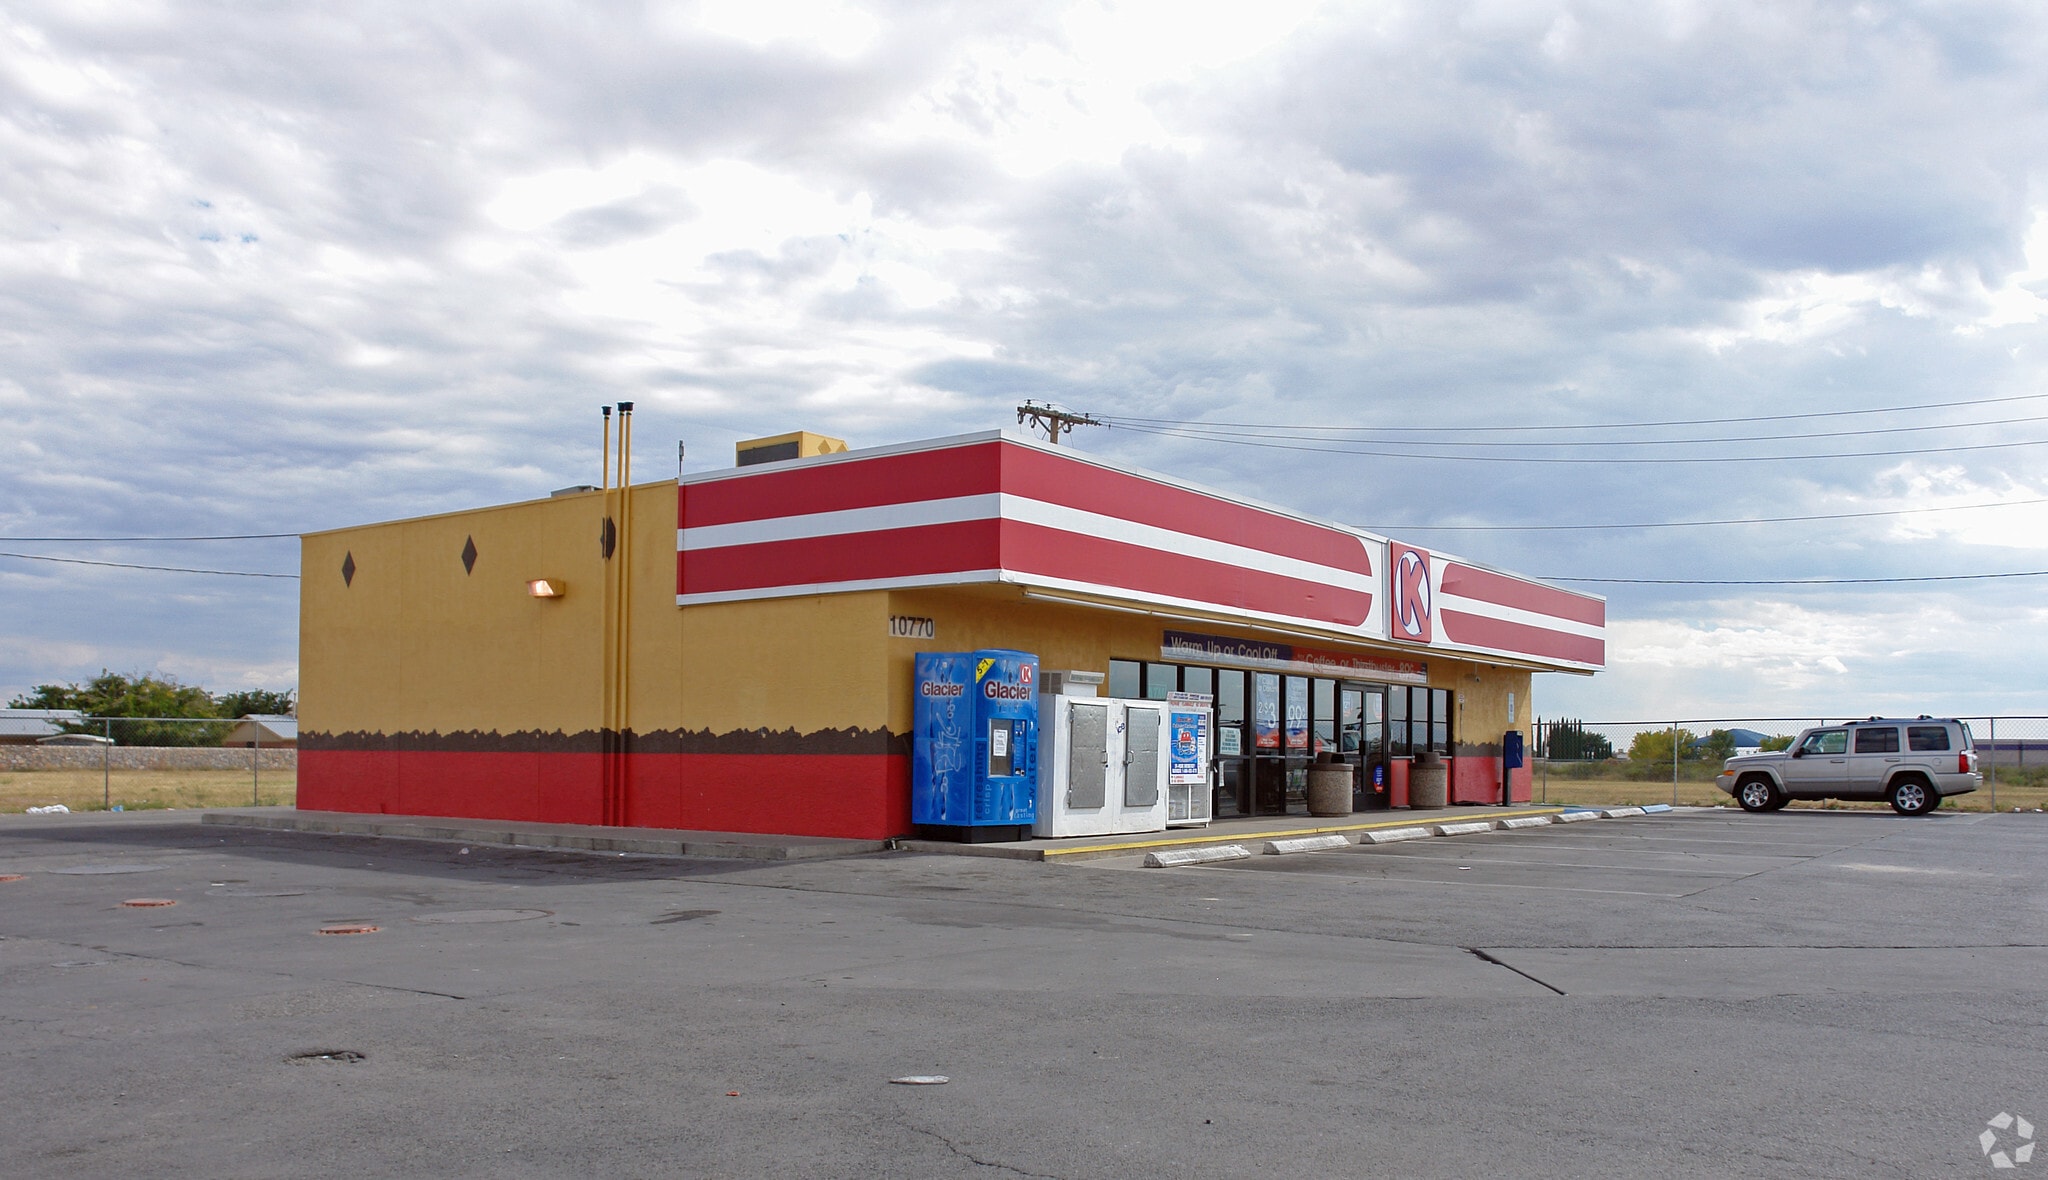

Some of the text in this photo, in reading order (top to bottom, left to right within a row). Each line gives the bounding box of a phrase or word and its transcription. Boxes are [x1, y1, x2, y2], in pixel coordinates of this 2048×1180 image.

[1399, 555, 1430, 637] K
[890, 615, 934, 637] 10770
[1170, 636, 1203, 655] Warm
[1207, 641, 1221, 661] Up
[1223, 645, 1235, 657] or
[1238, 644, 1261, 660] Cool
[1263, 647, 1279, 663] Off
[1306, 654, 1337, 667] Coffee
[1341, 659, 1350, 669] or
[921, 681, 964, 696] Glacier
[984, 680, 1032, 700] Glacier
[1028, 744, 1036, 799] water
[984, 784, 992, 815] crisp
